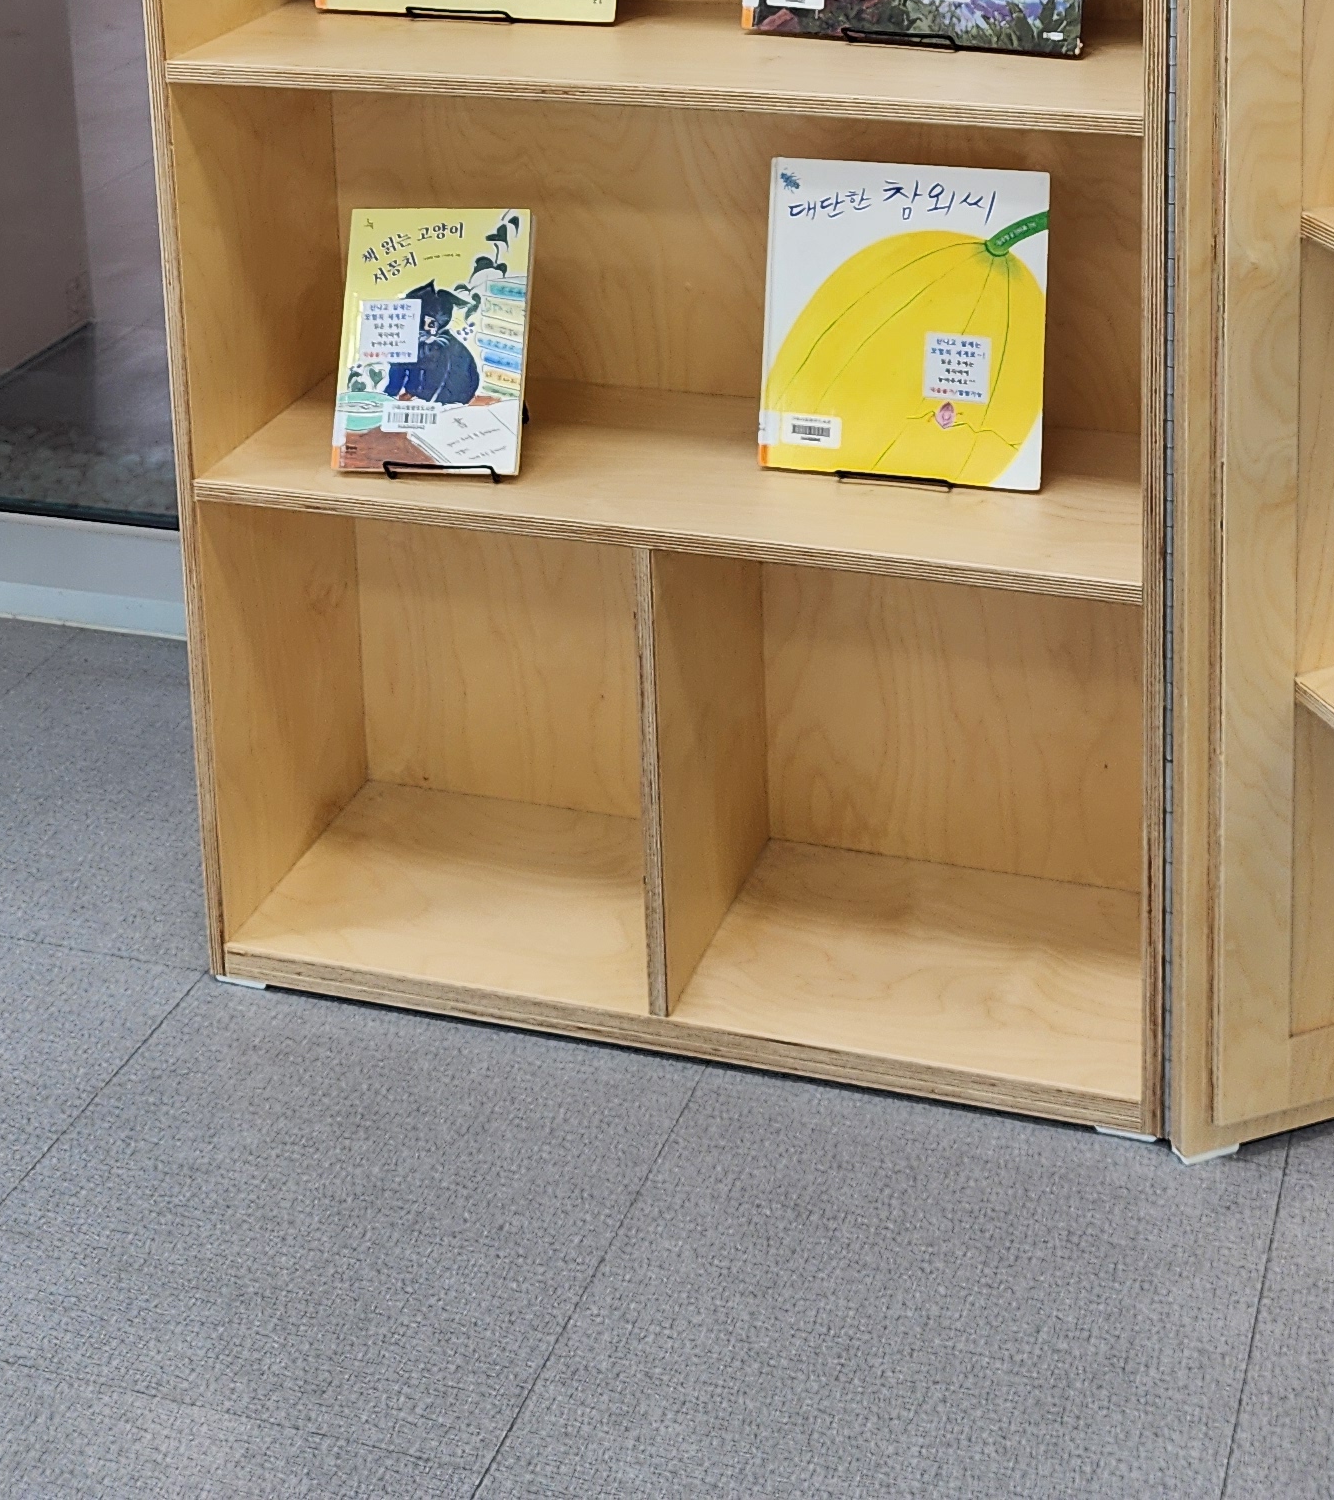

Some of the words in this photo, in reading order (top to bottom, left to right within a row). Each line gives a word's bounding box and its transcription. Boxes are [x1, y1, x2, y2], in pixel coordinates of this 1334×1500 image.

[789, 188, 873, 220] 대단한
[882, 179, 997, 225] 참외씨
[362, 247, 379, 263] 책
[381, 234, 411, 255] 읽는
[417, 222, 463, 241] 고양이
